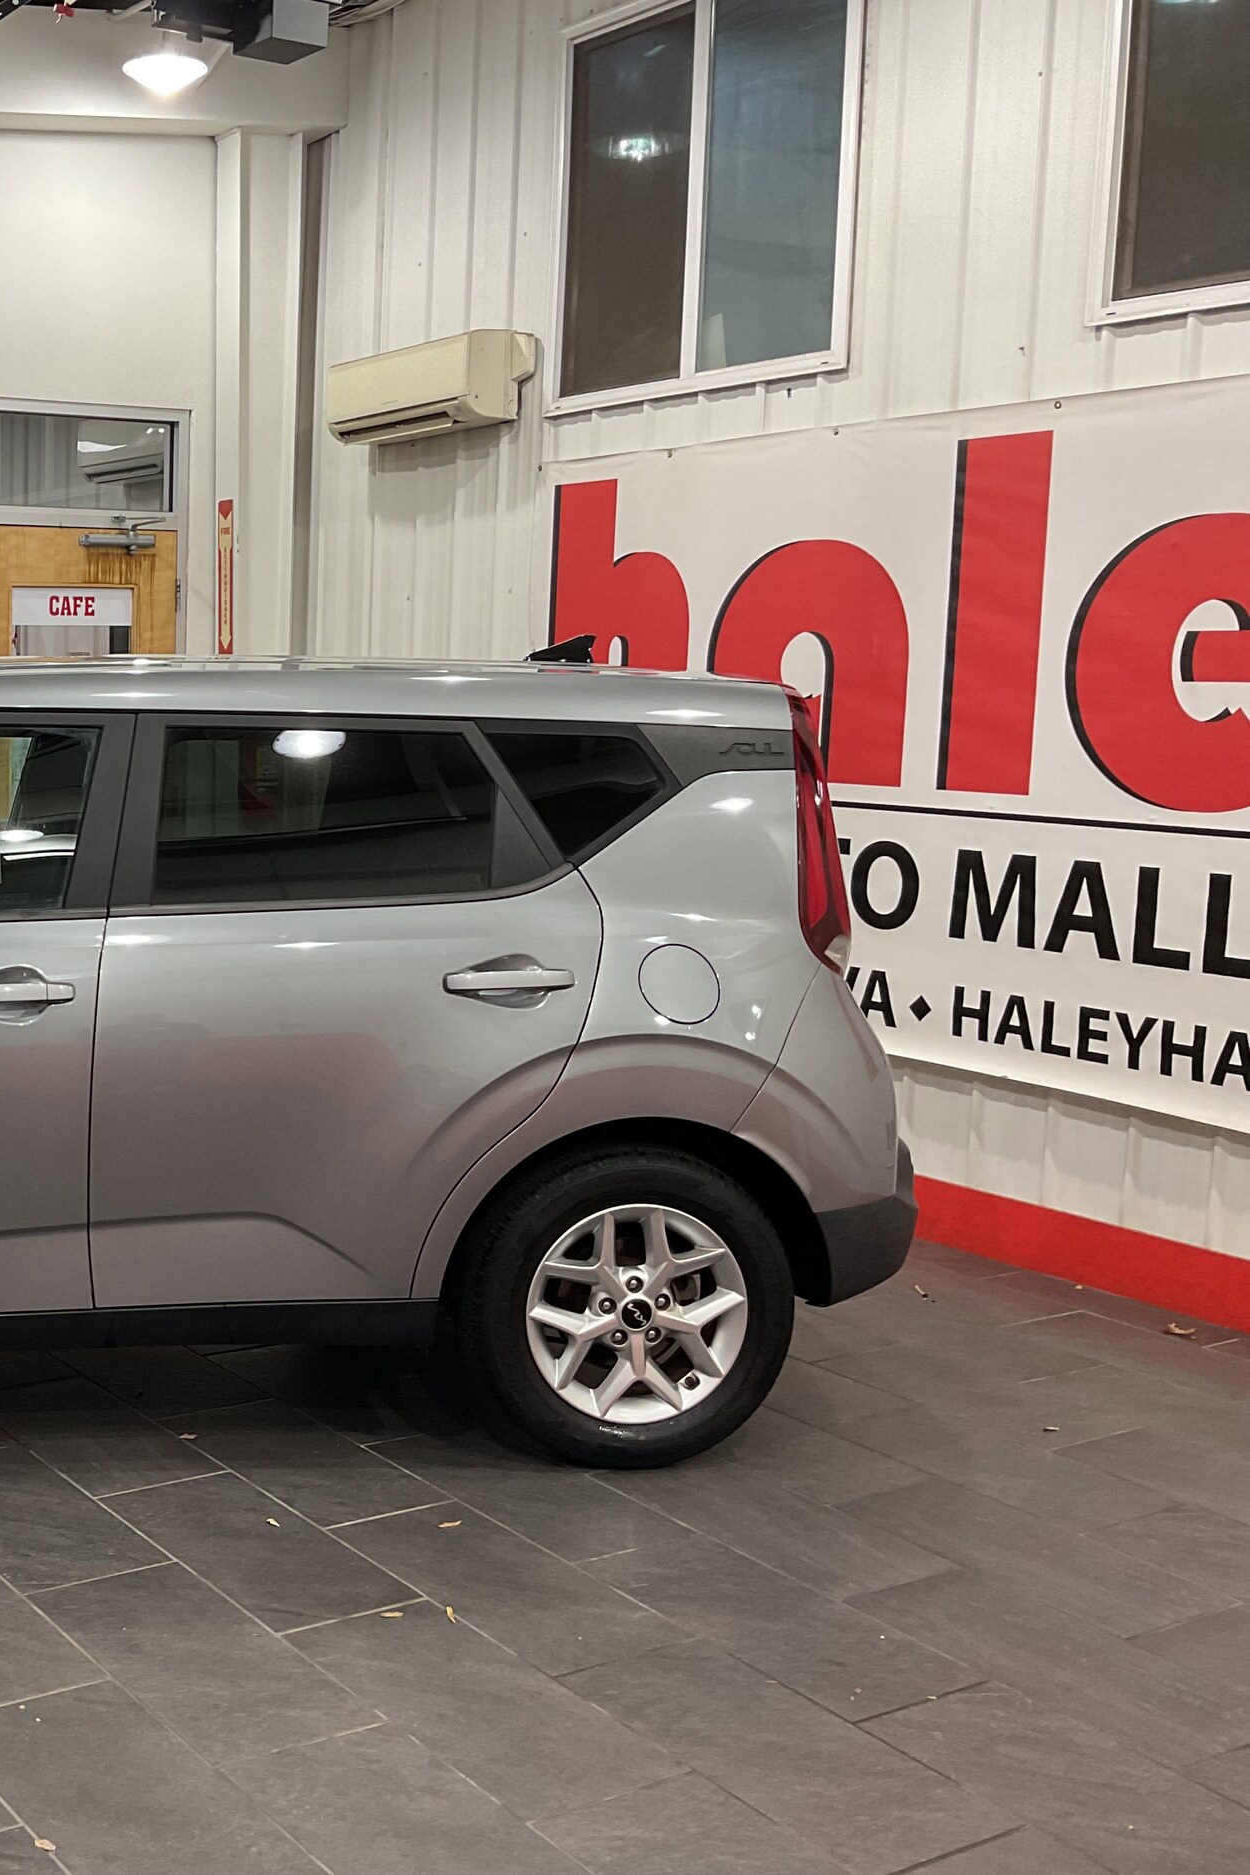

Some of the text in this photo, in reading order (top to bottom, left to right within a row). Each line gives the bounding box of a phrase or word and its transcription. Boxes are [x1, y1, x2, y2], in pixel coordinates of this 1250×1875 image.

[220, 527, 231, 536] FIRE
[49, 596, 95, 616] CAFE
[718, 742, 785, 756] SOUL
[948, 848, 1250, 980] MALL
